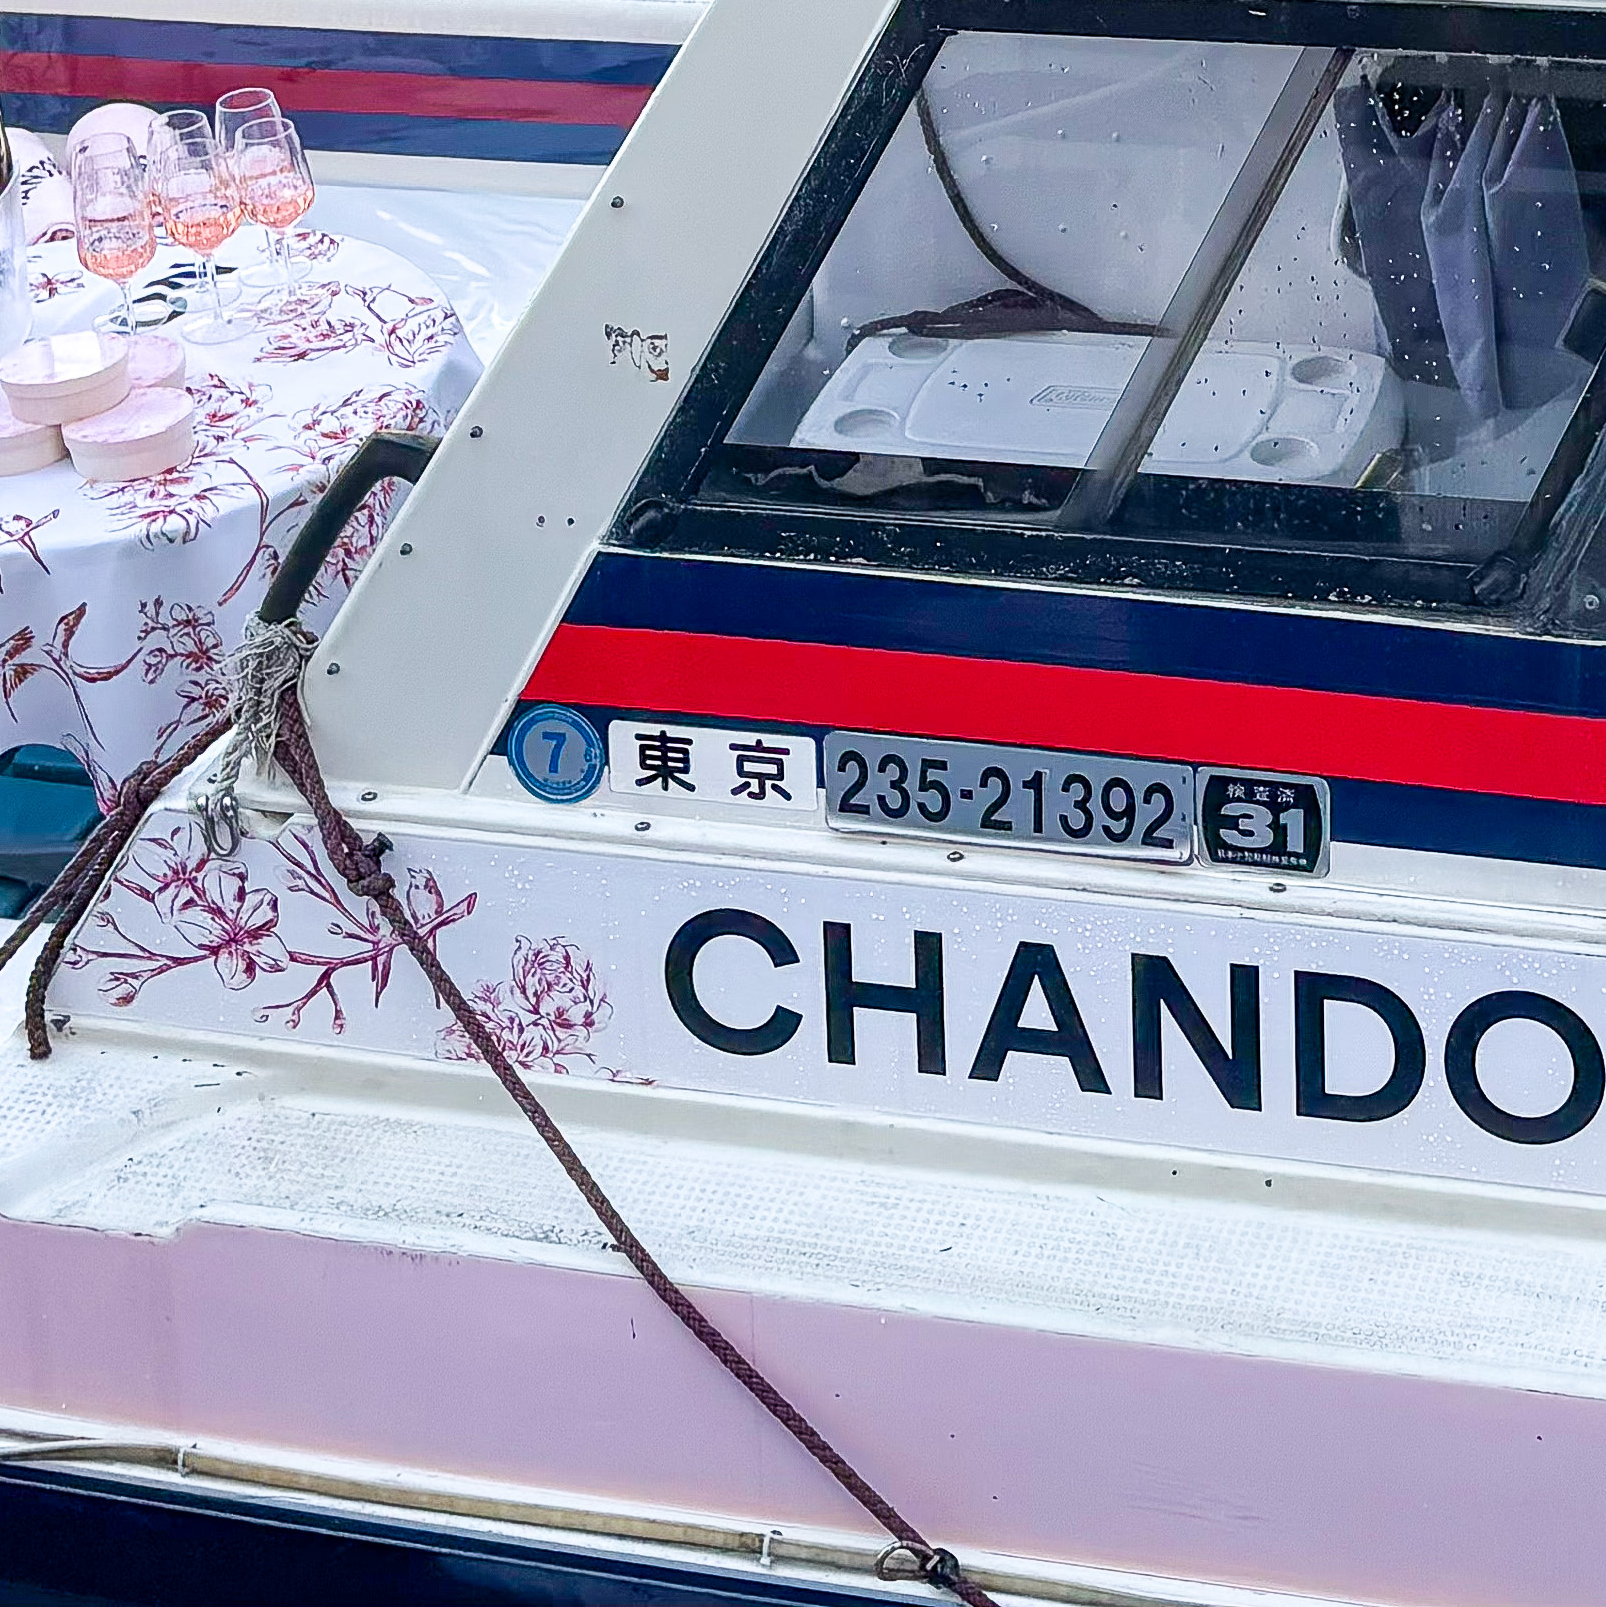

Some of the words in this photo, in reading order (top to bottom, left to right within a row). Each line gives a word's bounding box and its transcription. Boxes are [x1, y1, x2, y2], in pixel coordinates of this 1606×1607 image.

[541, 730, 567, 774] 7
[633, 730, 793, 801] 東京
[836, 749, 1176, 850] 235-21392
[1219, 802, 1305, 854] 31
